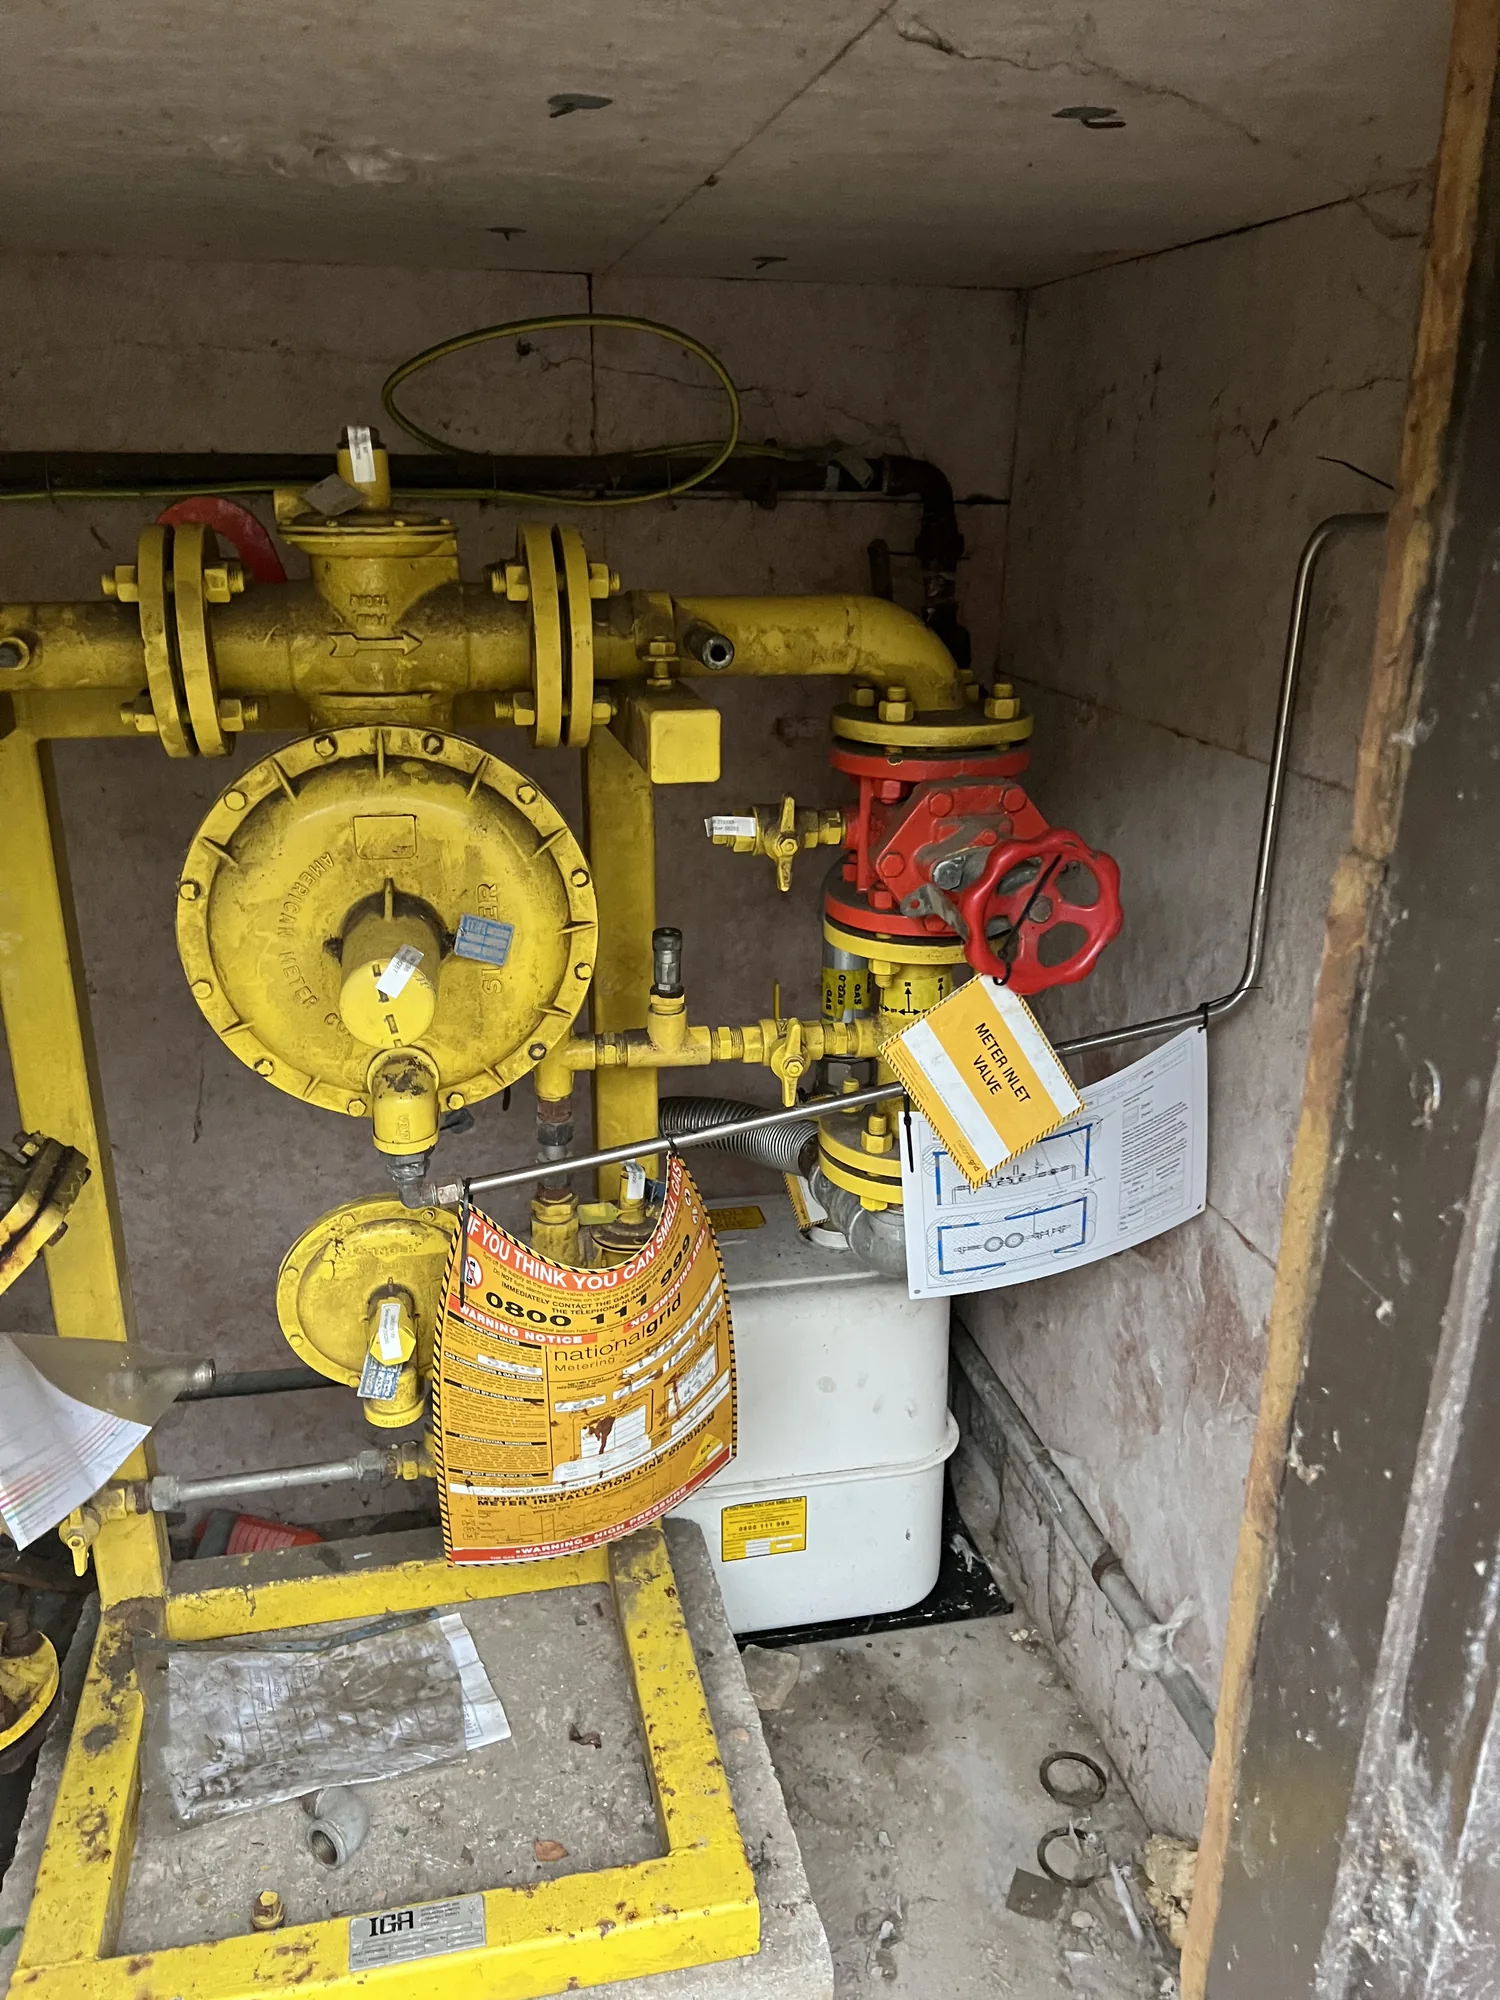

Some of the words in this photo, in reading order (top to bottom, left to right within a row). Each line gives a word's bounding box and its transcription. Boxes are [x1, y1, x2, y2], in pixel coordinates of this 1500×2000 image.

[277, 852, 334, 937] AMERICAN
[476, 883, 502, 994] SIER
[279, 951, 318, 1010] METER
[825, 990, 833, 1010] GAS
[854, 984, 862, 1005] GAS
[973, 1055, 1002, 1095] VALVE
[974, 1022, 1008, 1068] METER
[1002, 1067, 1031, 1102] INLET
[467, 1215, 481, 1236] IF
[483, 1224, 510, 1261] YOU
[514, 1249, 568, 1287] THINK
[572, 1272, 617, 1289] YOU
[623, 1245, 655, 1279] CAN
[656, 1196, 677, 1249] SMELL
[671, 1162, 682, 1196] GAS
[485, 1291, 572, 1327] 0800
[660, 1234, 690, 1288] 999
[501, 1272, 512, 1282] NOT
[508, 1269, 524, 1283] supply
[544, 1286, 565, 1295] control
[630, 1312, 649, 1328] NO
[653, 1261, 692, 1313] SMOKING
[692, 1228, 706, 1261] AREA
[501, 1281, 550, 1304] IMMEDIATELY
[552, 1301, 592, 1309] CONTACT
[613, 1293, 629, 1302] GAS
[552, 1307, 568, 1315] THE
[570, 1302, 619, 1315] TELEPHONE
[459, 1305, 519, 1337] WARNING
[524, 1331, 583, 1344] NOTICE
[496, 1312, 515, 1323] supply
[554, 1293, 681, 1361] nationalgrid
[464, 1321, 499, 1340] NON-RETURN
[499, 1335, 520, 1345] VALVES
[445, 1351, 456, 1360] GAS
[456, 1356, 497, 1375] COMPRESSORS
[554, 1357, 616, 1373] Metering
[460, 1384, 481, 1394] METER
[534, 1476, 632, 1504] INSTALLATION
[637, 1455, 664, 1476] LINE
[668, 1410, 715, 1457] DIAGRAM
[515, 1491, 566, 1500] INTERFERE
[569, 1486, 592, 1495] WITH
[520, 1539, 584, 1554] WARNING
[594, 1524, 625, 1539] HIGH
[629, 1486, 687, 1525] PRESSURE
[738, 1524, 757, 1532] 0800
[369, 1910, 414, 1937] IGA
